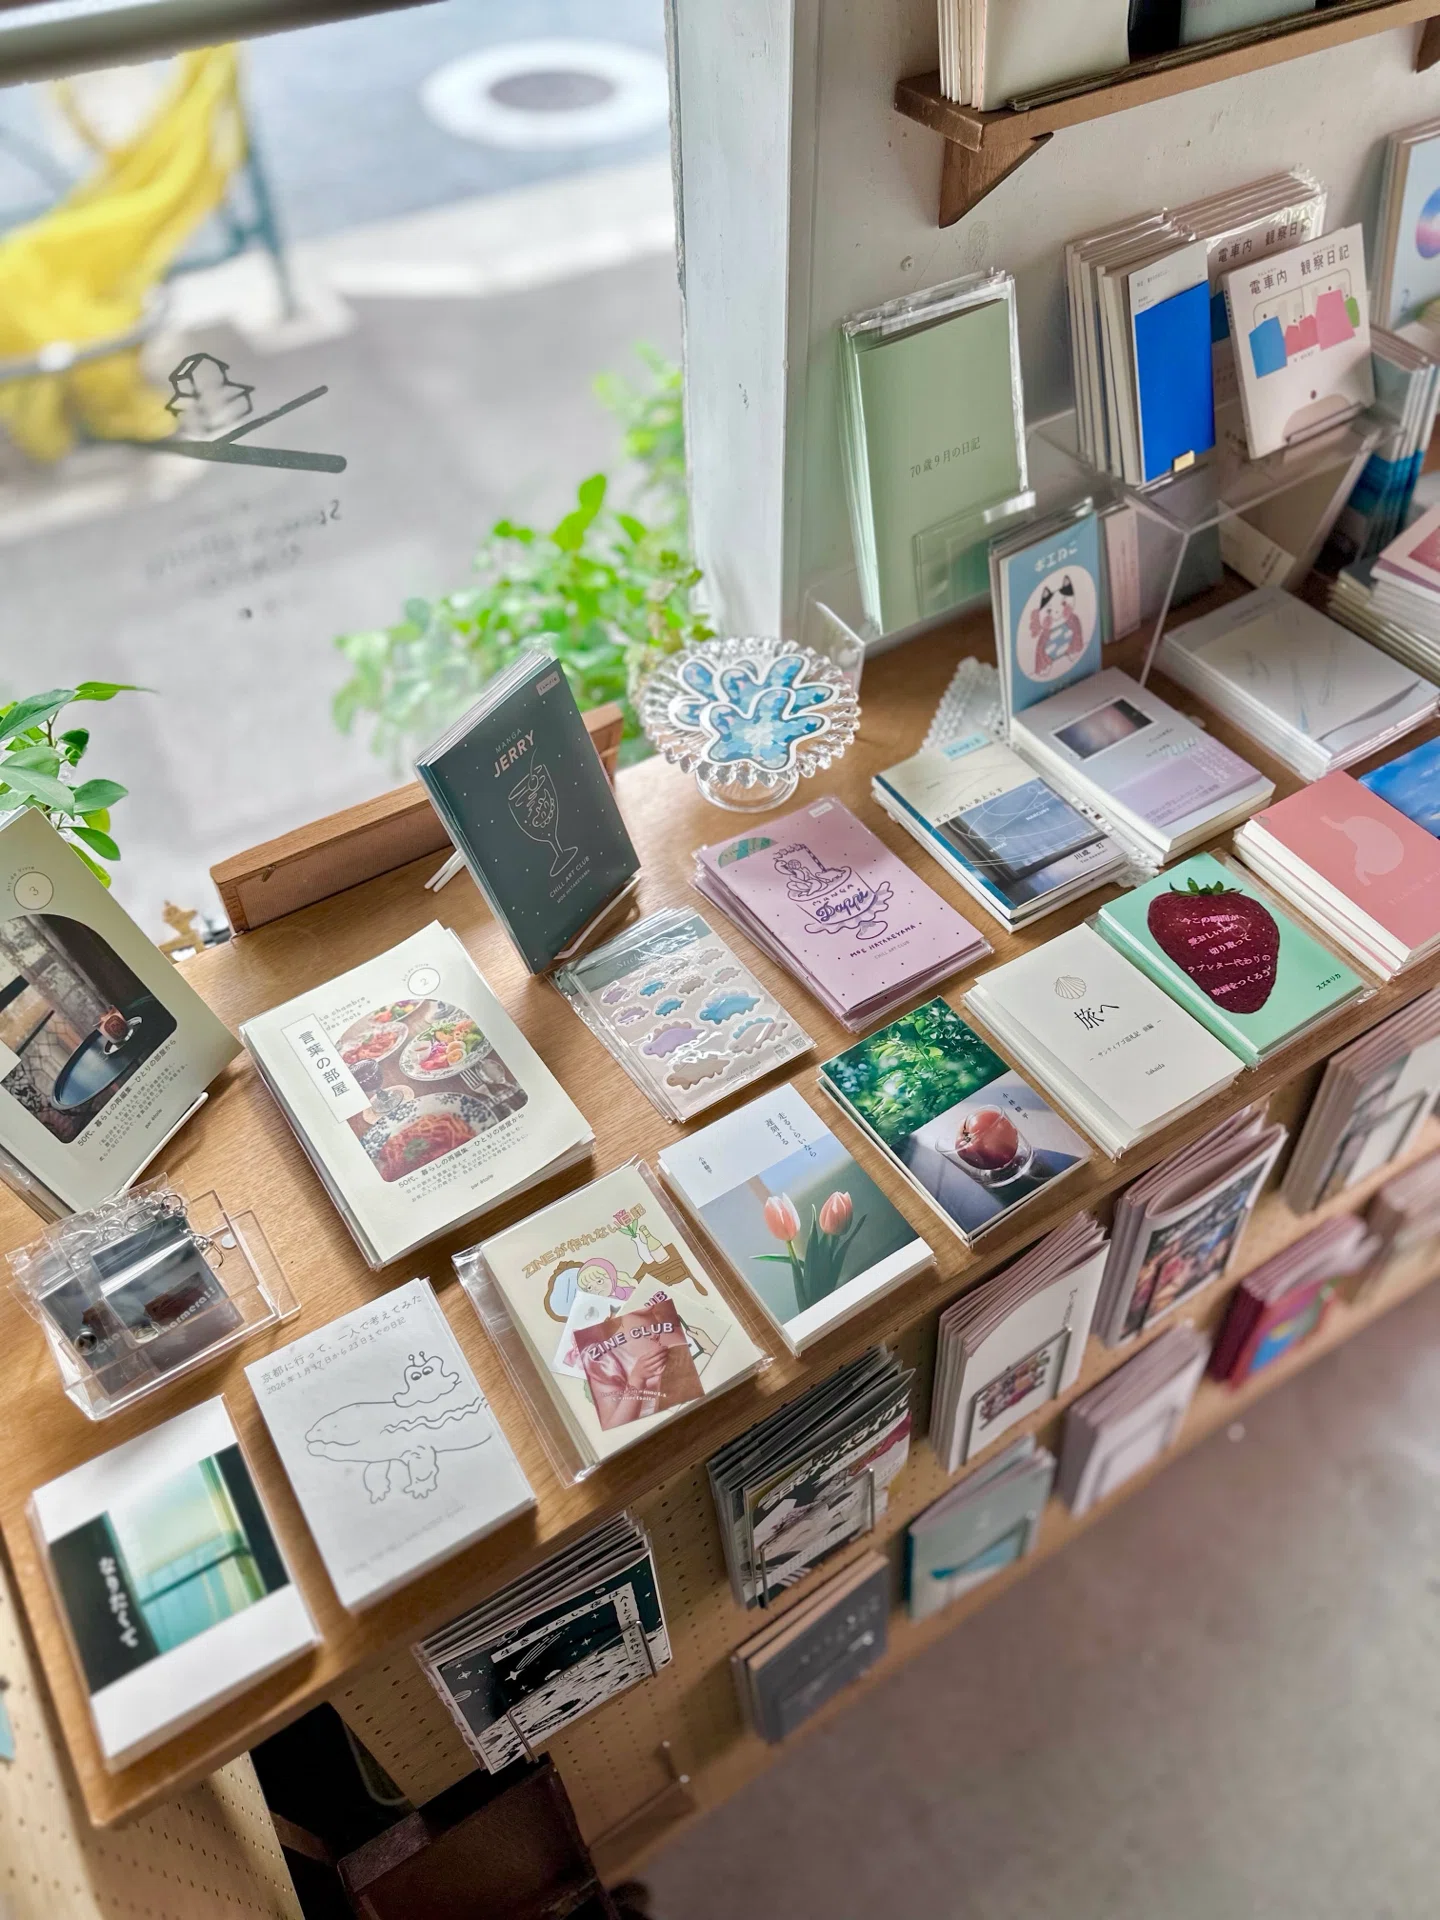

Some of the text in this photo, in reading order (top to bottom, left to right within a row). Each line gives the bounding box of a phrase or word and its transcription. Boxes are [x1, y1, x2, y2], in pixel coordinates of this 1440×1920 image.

[1218, 240, 1252, 263] 電車内
[1249, 245, 1350, 295] 電車内 観察日記
[909, 436, 981, 478] 70歳9月の日記
[492, 730, 536, 778] JERRY
[495, 728, 522, 754] MANGA
[548, 855, 590, 898] CHILL ART CLUB
[30, 886, 39, 896] 3
[850, 924, 917, 958] MOE HATAKEYAMA
[1209, 934, 1252, 956] 切り取って
[1188, 954, 1271, 973] ラブレター代わりの
[420, 976, 429, 986] 2
[1316, 973, 1342, 991] スズキリカ
[330, 996, 366, 1017] chambre
[1073, 1003, 1120, 1031] 旅へ
[299, 1030, 349, 1097] 言葉の部屋
[764, 1118, 790, 1146] 遅刻する
[777, 1112, 817, 1158] 走るくらいなら
[521, 1203, 647, 1278] ZINEが作れない日記
[588, 1322, 674, 1360] ZINE CLUB
